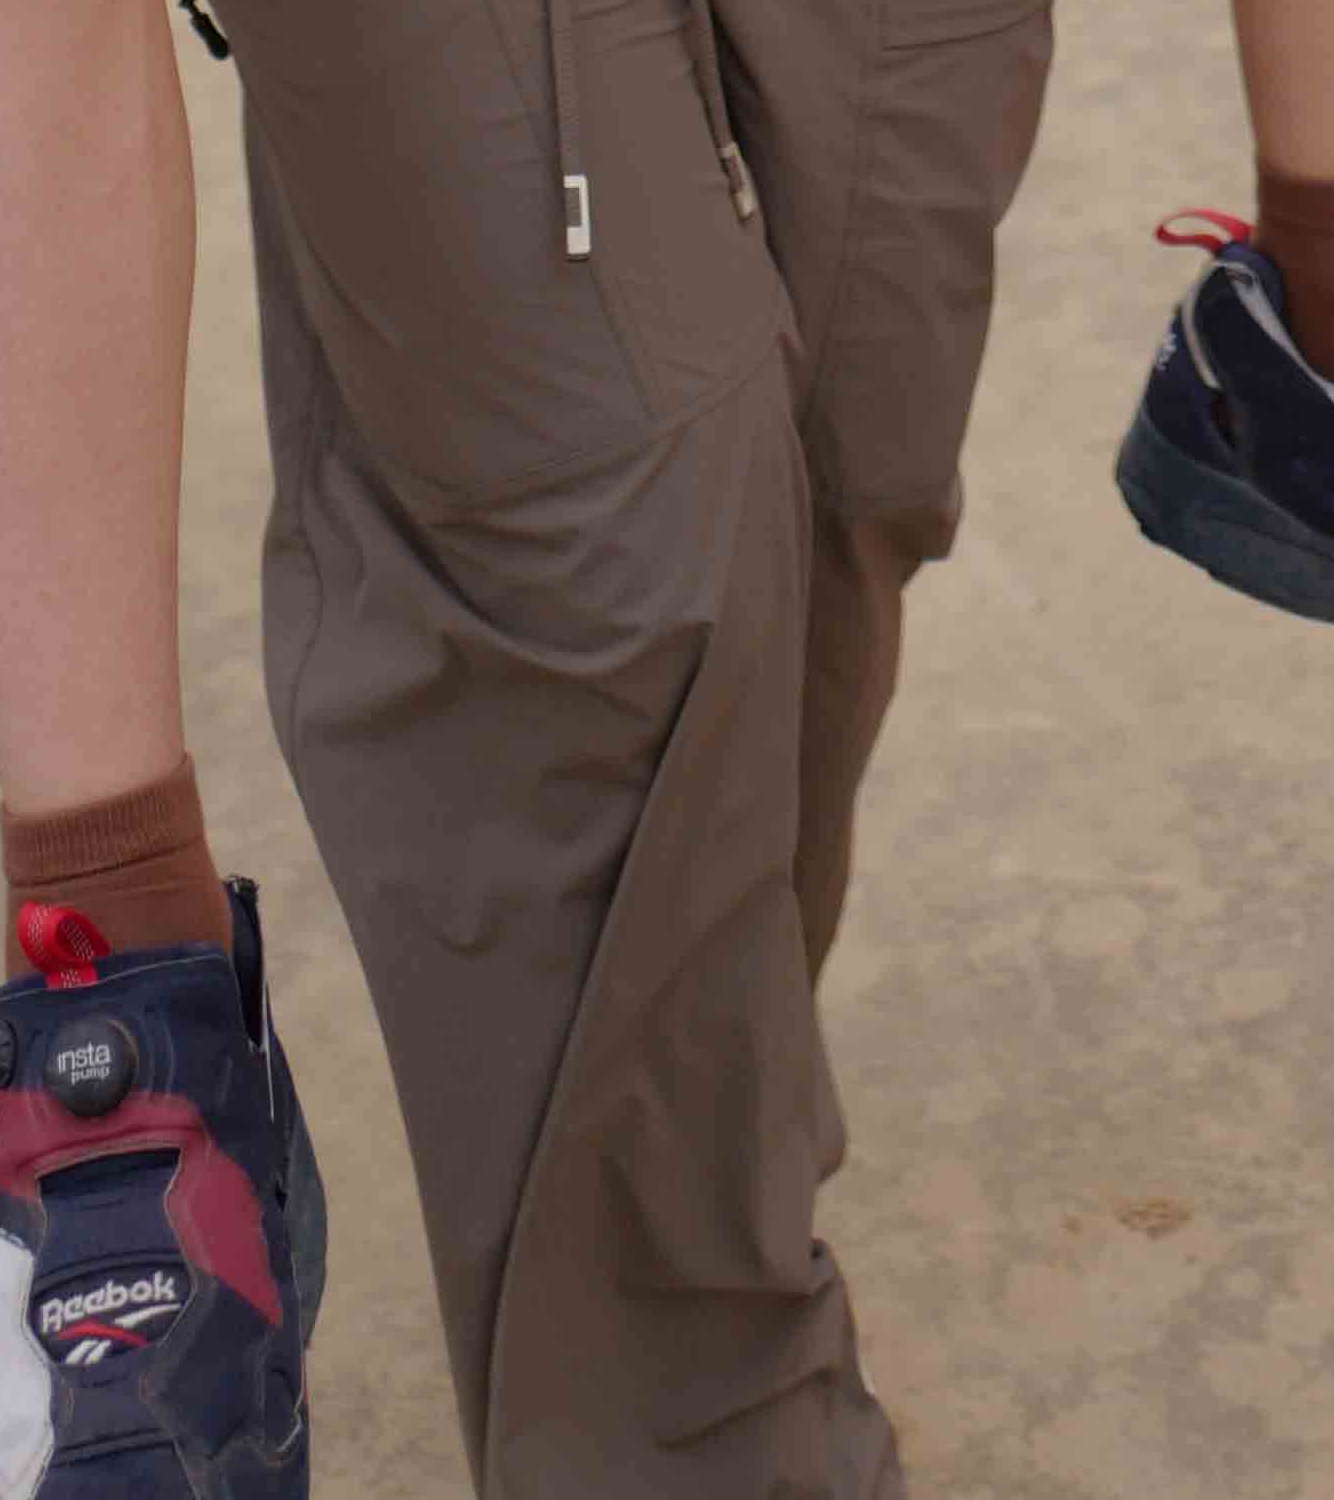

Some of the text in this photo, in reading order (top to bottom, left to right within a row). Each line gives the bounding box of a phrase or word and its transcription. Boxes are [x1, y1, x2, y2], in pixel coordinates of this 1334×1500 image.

[57, 1041, 112, 1075] insta
[71, 1066, 110, 1086] pump
[41, 1269, 176, 1335] Reebok
